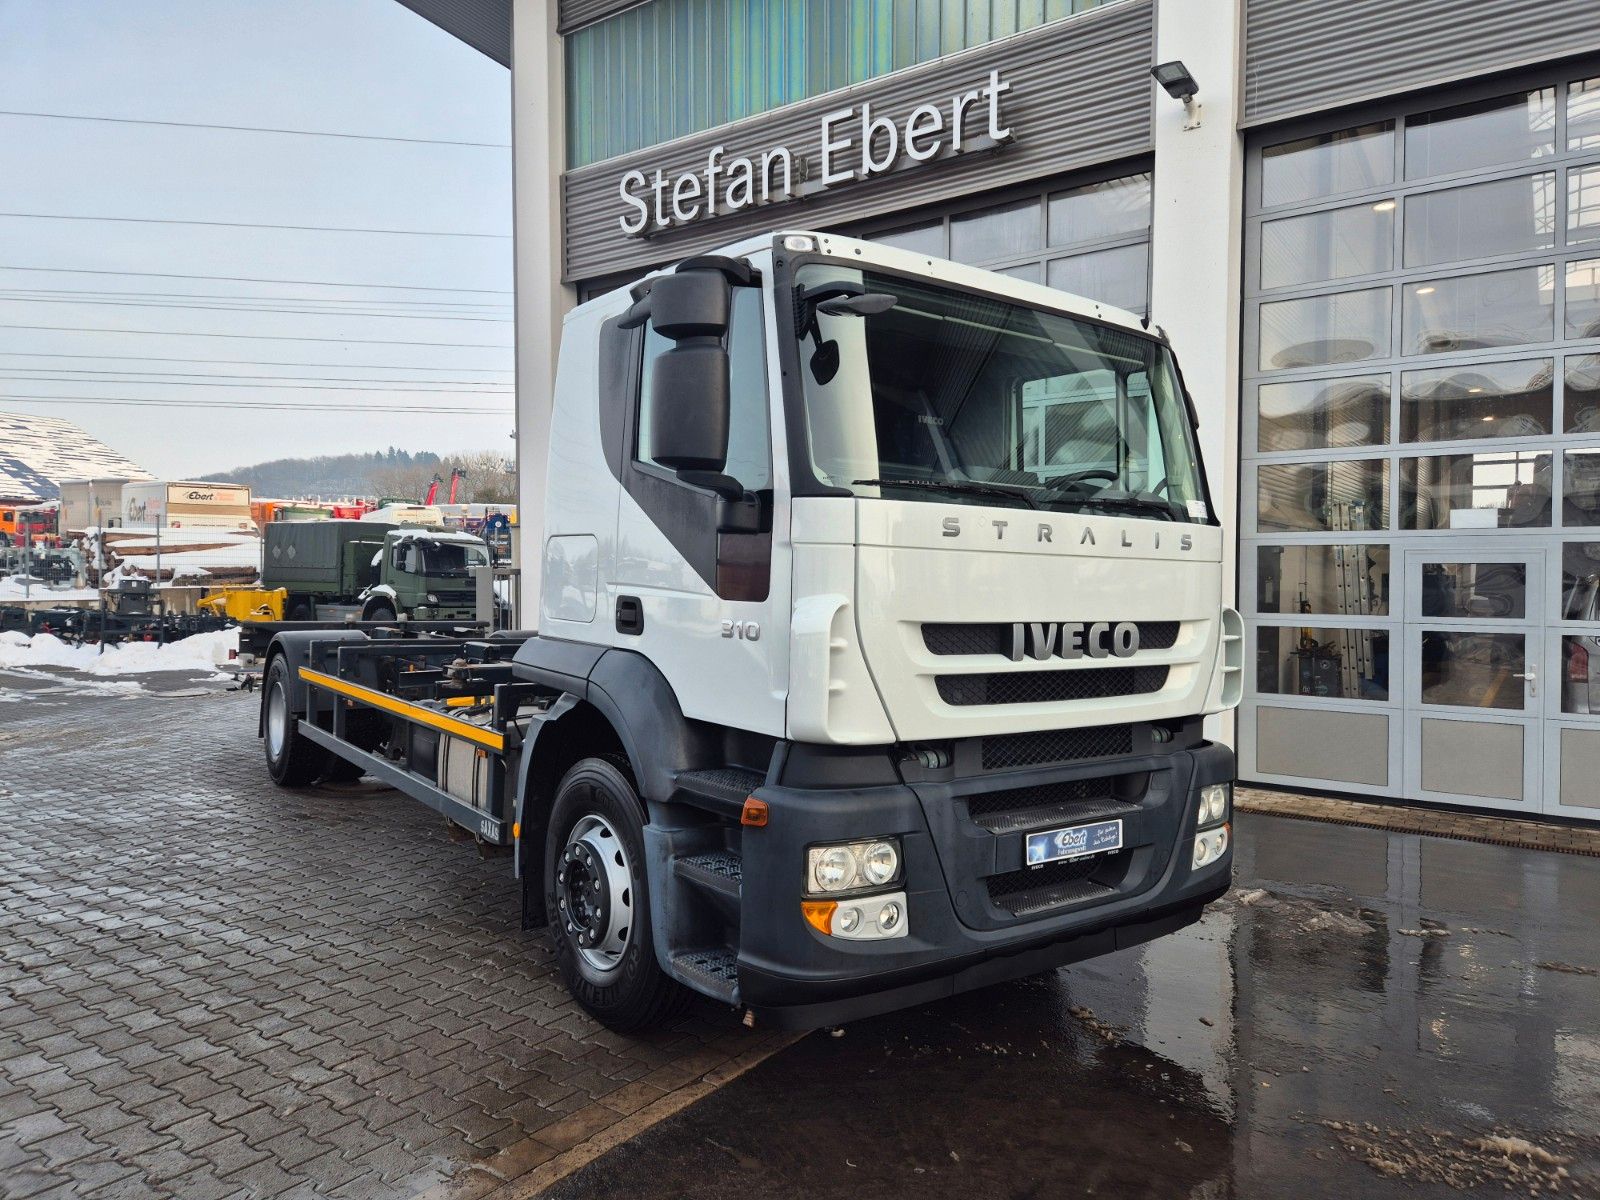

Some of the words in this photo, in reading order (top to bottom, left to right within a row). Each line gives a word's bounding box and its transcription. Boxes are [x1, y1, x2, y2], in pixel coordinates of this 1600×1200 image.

[619, 145, 793, 234] Stefan
[820, 69, 1013, 186] Ebert
[942, 516, 1193, 551] STRALIS
[721, 619, 761, 642] 310
[1011, 621, 1141, 662] IVECO
[1060, 829, 1087, 848] Ebert
